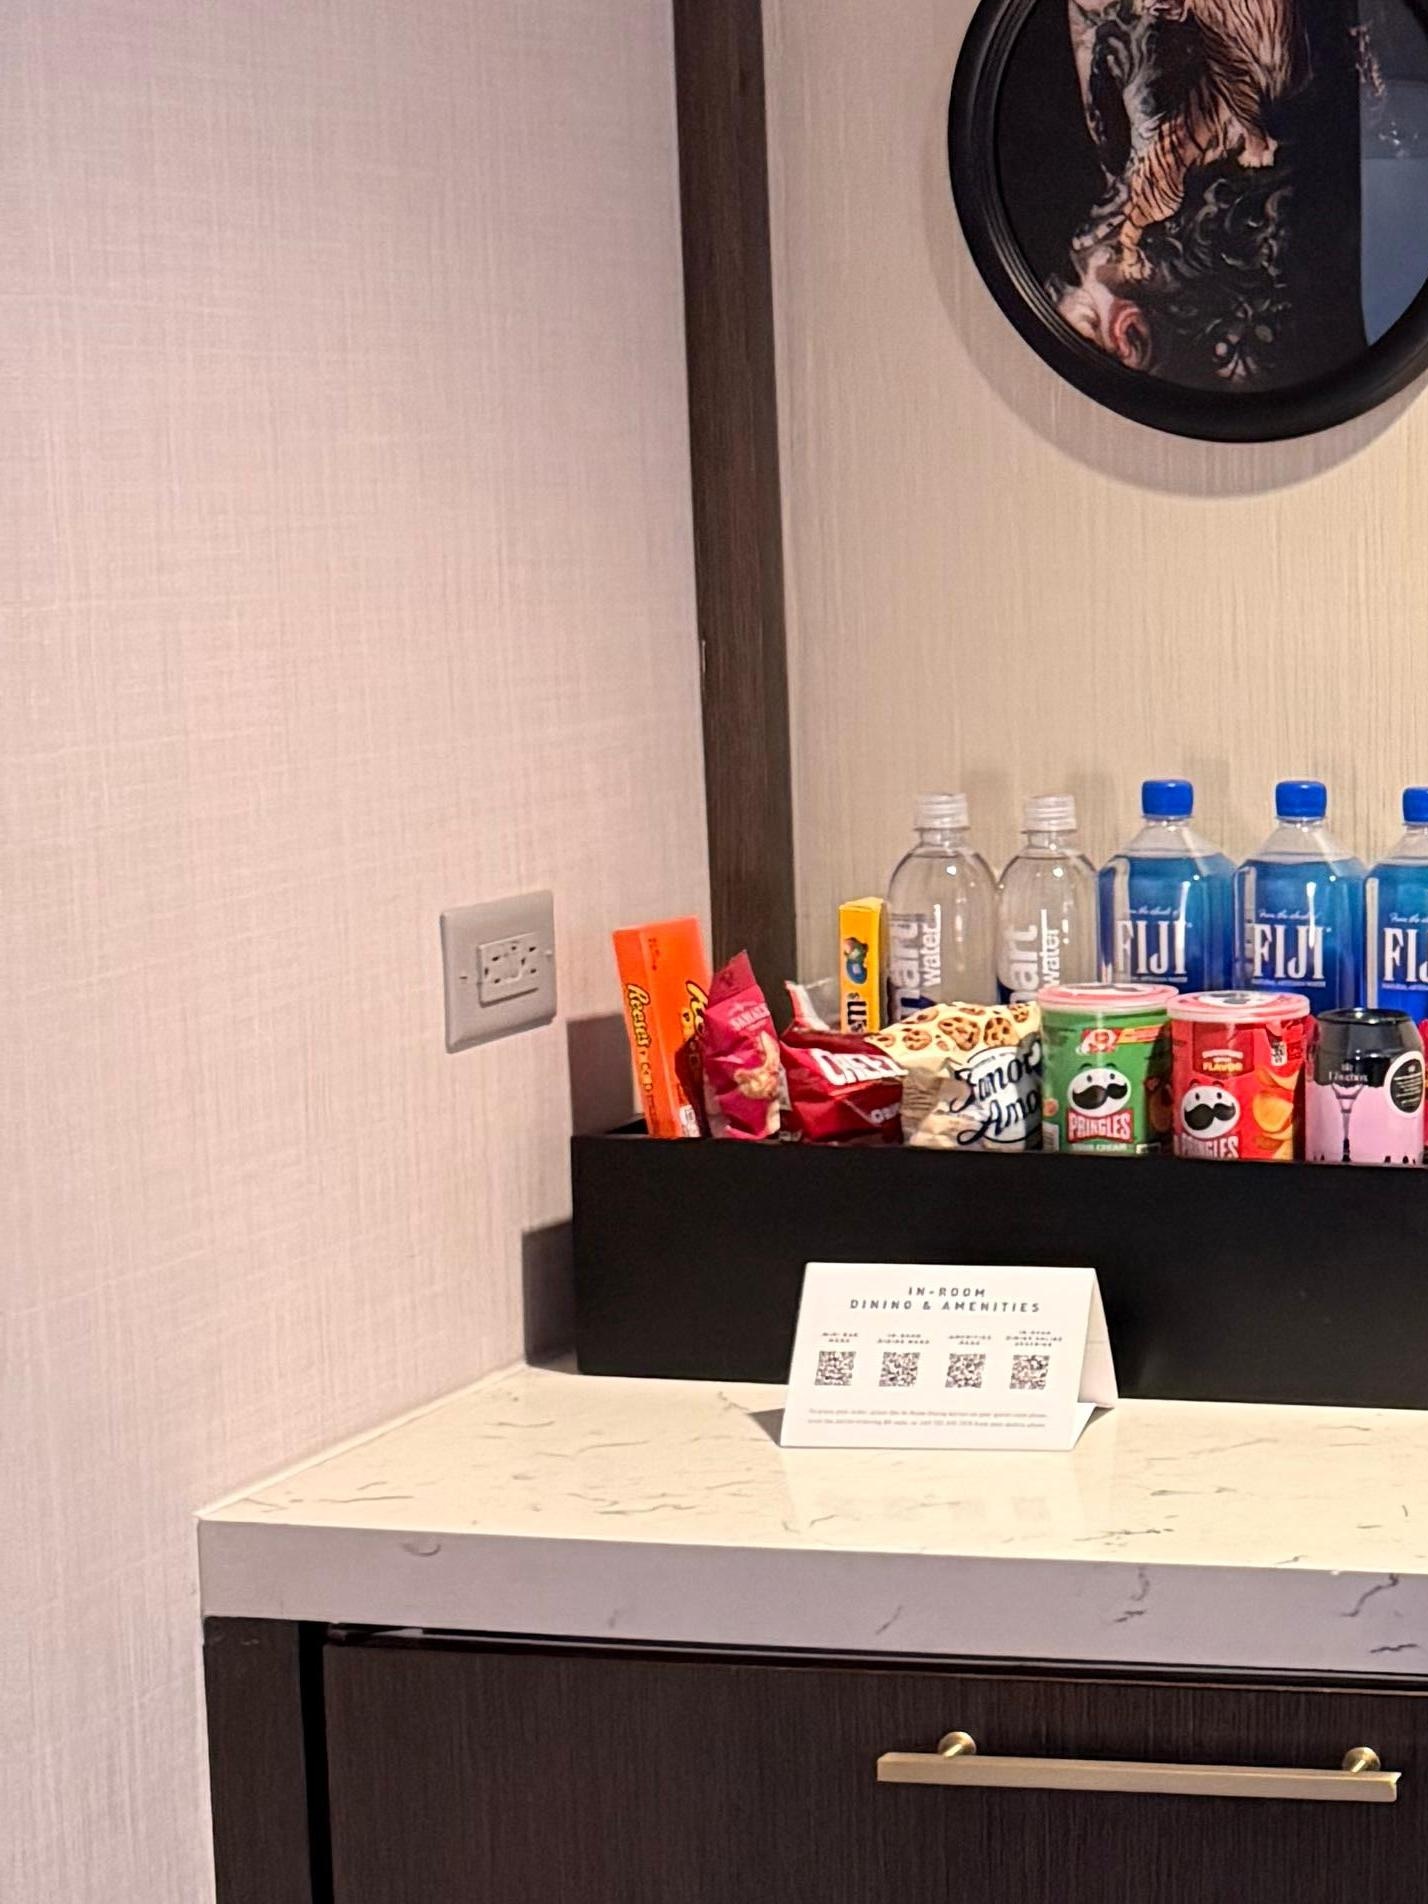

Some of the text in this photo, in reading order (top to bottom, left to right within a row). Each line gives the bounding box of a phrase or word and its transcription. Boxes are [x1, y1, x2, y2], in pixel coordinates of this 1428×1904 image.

[889, 919, 921, 1022] mart
[921, 916, 941, 987] water
[1004, 924, 1040, 1004] art
[1040, 921, 1060, 986] water
[1115, 920, 1187, 974] FIJI
[1253, 923, 1324, 979] FIJI
[957, 1089, 1039, 1146] Amo
[1068, 1112, 1132, 1142] PRINGLES
[850, 1299, 1040, 1313] DINING & AMENITIES
[907, 1286, 986, 1298] IN-ROOM
